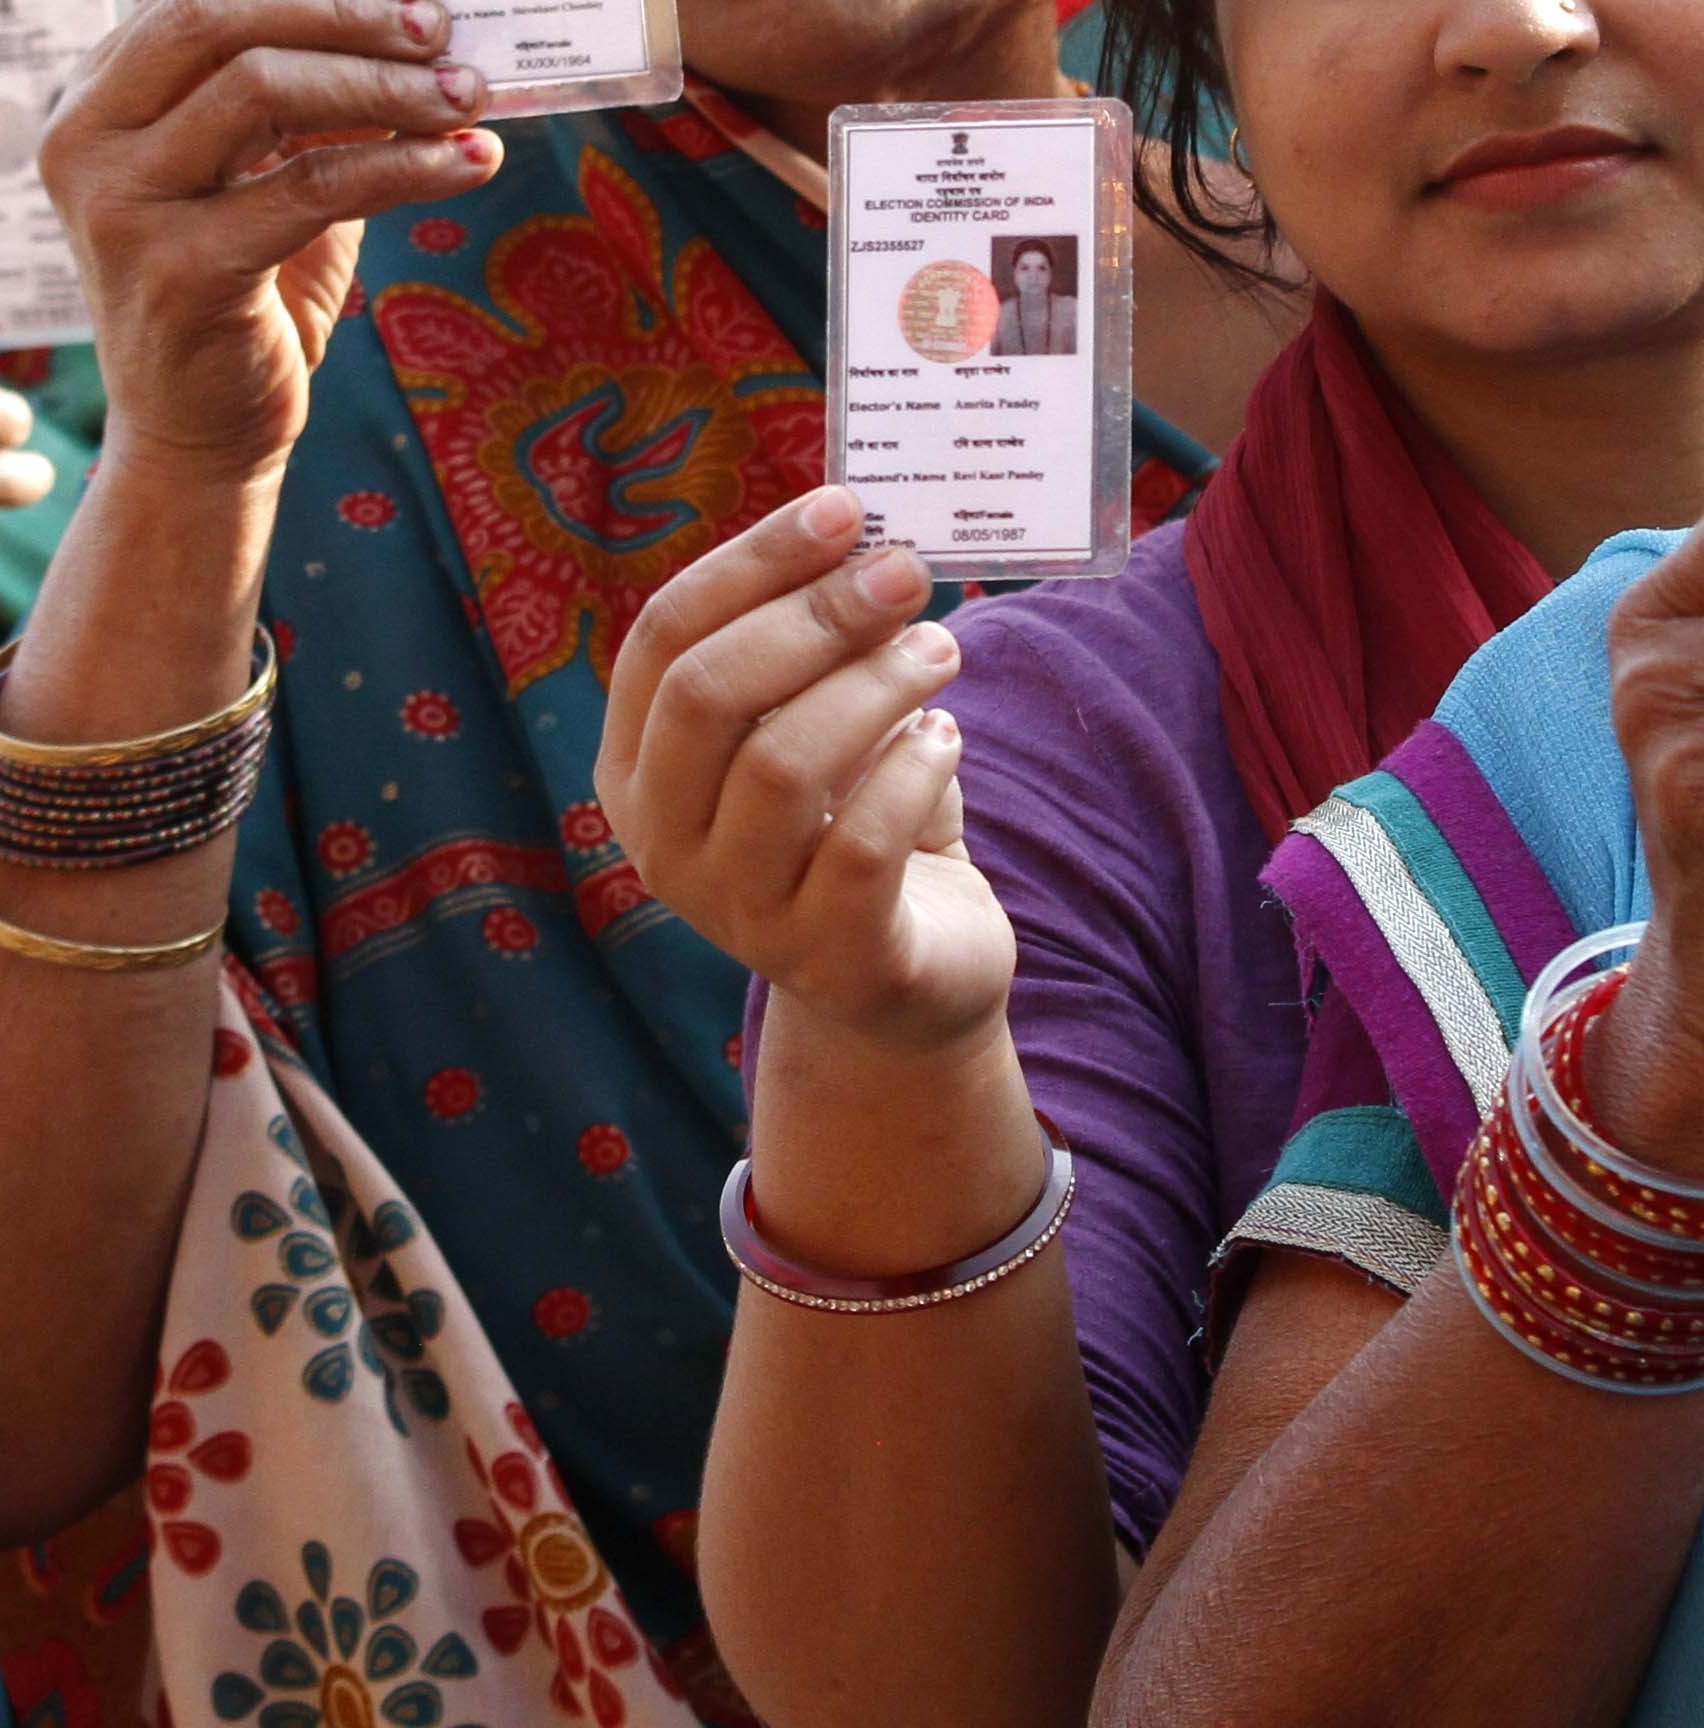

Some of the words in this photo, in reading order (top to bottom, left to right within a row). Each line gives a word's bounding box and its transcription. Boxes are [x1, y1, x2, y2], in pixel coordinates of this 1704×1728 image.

[474, 10, 505, 19] Name
[865, 200, 923, 210] ELECTION
[926, 197, 1002, 209] COMMISSION
[1004, 197, 1020, 207] OF
[1024, 196, 1055, 206] INDIA
[910, 211, 969, 222] IDENTITY
[972, 210, 1009, 221] CARD
[849, 400, 901, 412] Elector's
[906, 401, 941, 411] Name
[954, 399, 994, 409] Amrita
[998, 398, 1040, 410] Pandey
[848, 473, 908, 484] Husband's
[912, 472, 946, 481] Name
[953, 470, 976, 480] Ravi
[1008, 470, 1044, 481] Pandey
[952, 528, 1026, 542] 08/05/1987
